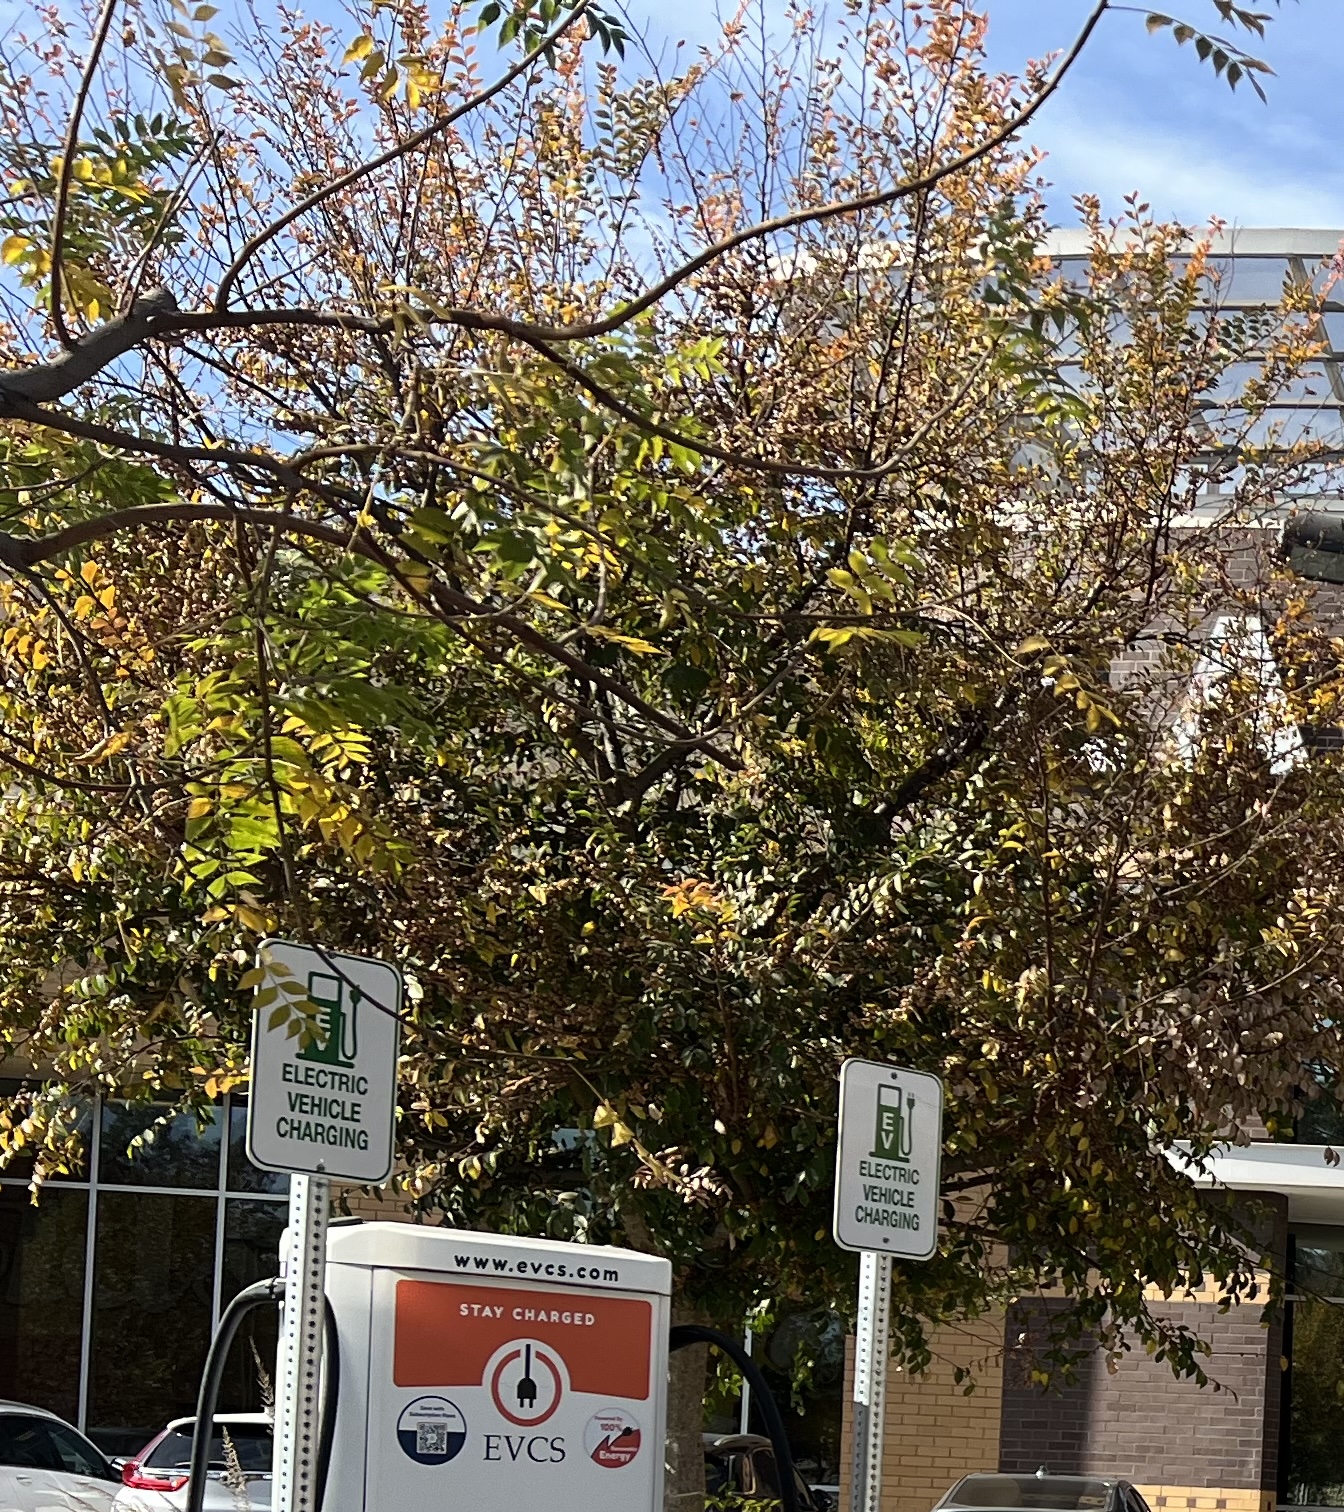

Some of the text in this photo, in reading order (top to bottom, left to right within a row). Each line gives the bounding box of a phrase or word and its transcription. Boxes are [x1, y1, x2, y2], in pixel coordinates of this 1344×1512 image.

[281, 1062, 369, 1096] ELECTRIC
[287, 1091, 362, 1124] VEHICLE
[275, 1116, 369, 1151] CHARGING
[880, 1112, 895, 1150] EV
[859, 1160, 920, 1186] ELECTRIC
[862, 1183, 915, 1209] VEHICLE
[854, 1204, 920, 1232] CHARGING
[453, 1254, 619, 1283] www.evcs.com
[459, 1303, 596, 1327] STAY CHARGED
[483, 1434, 566, 1464] EVCS
